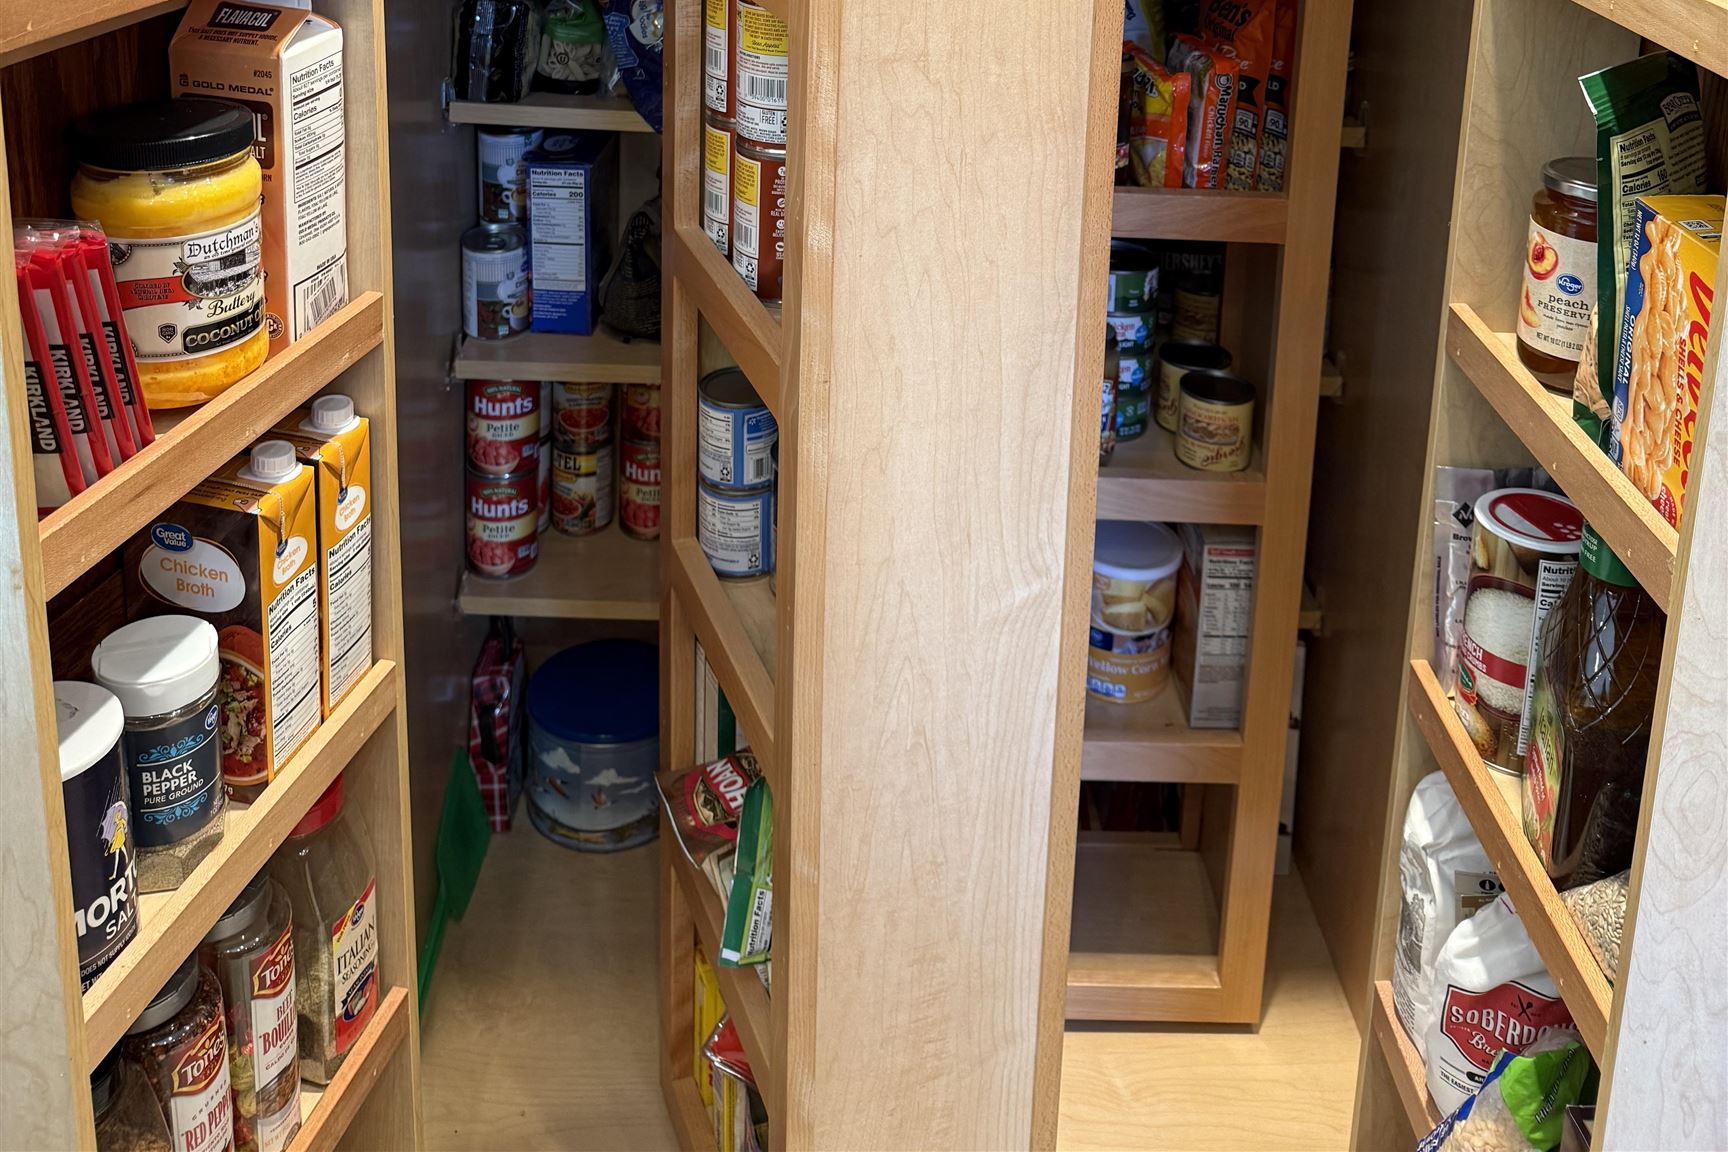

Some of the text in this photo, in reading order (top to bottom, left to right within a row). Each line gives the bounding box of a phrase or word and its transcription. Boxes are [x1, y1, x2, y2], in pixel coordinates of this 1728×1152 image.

[215, 7, 274, 28] FLAVACOL
[253, 70, 272, 79] #2045
[292, 60, 334, 85] Nutrition Facts
[192, 81, 272, 96] GOLD MEDAL
[293, 105, 317, 121] Calories
[761, 116, 775, 125] FREE
[1215, 86, 1233, 150] Maruchan
[1238, 117, 1249, 130] 90
[1269, 118, 1280, 130] 90
[250, 148, 265, 159] ALT
[1622, 179, 1652, 193] Calories
[186, 220, 259, 259] Dutchman's
[1558, 277, 1582, 291] Kroger
[206, 292, 256, 319] Buttery
[1548, 294, 1590, 311] peach
[185, 317, 252, 347] COCONUT
[1622, 315, 1636, 385] ORIGINAL
[1676, 336, 1687, 389] SHELLS
[50, 348, 85, 434] KIRKLAND
[25, 366, 57, 451] KIRKLAND
[486, 422, 520, 433] Petite
[1672, 404, 1682, 467] CHEESE
[156, 527, 187, 542] Great
[482, 523, 516, 534] Petite
[164, 537, 187, 548] Value
[329, 531, 355, 559] Nutrition
[160, 557, 229, 583] Chicken
[330, 570, 352, 590] Calories
[176, 578, 215, 598] Broth
[268, 567, 315, 616] Nutrition Facts
[270, 624, 292, 649] Calories
[141, 759, 194, 783] BLACK
[143, 770, 198, 796] PEPPER
[144, 778, 204, 805] PURE GROUND
[753, 890, 765, 917] Facts
[337, 915, 375, 976] ITALIAN
[1440, 1070, 1474, 1094] THE EASIEST
[185, 1121, 207, 1152] RED
